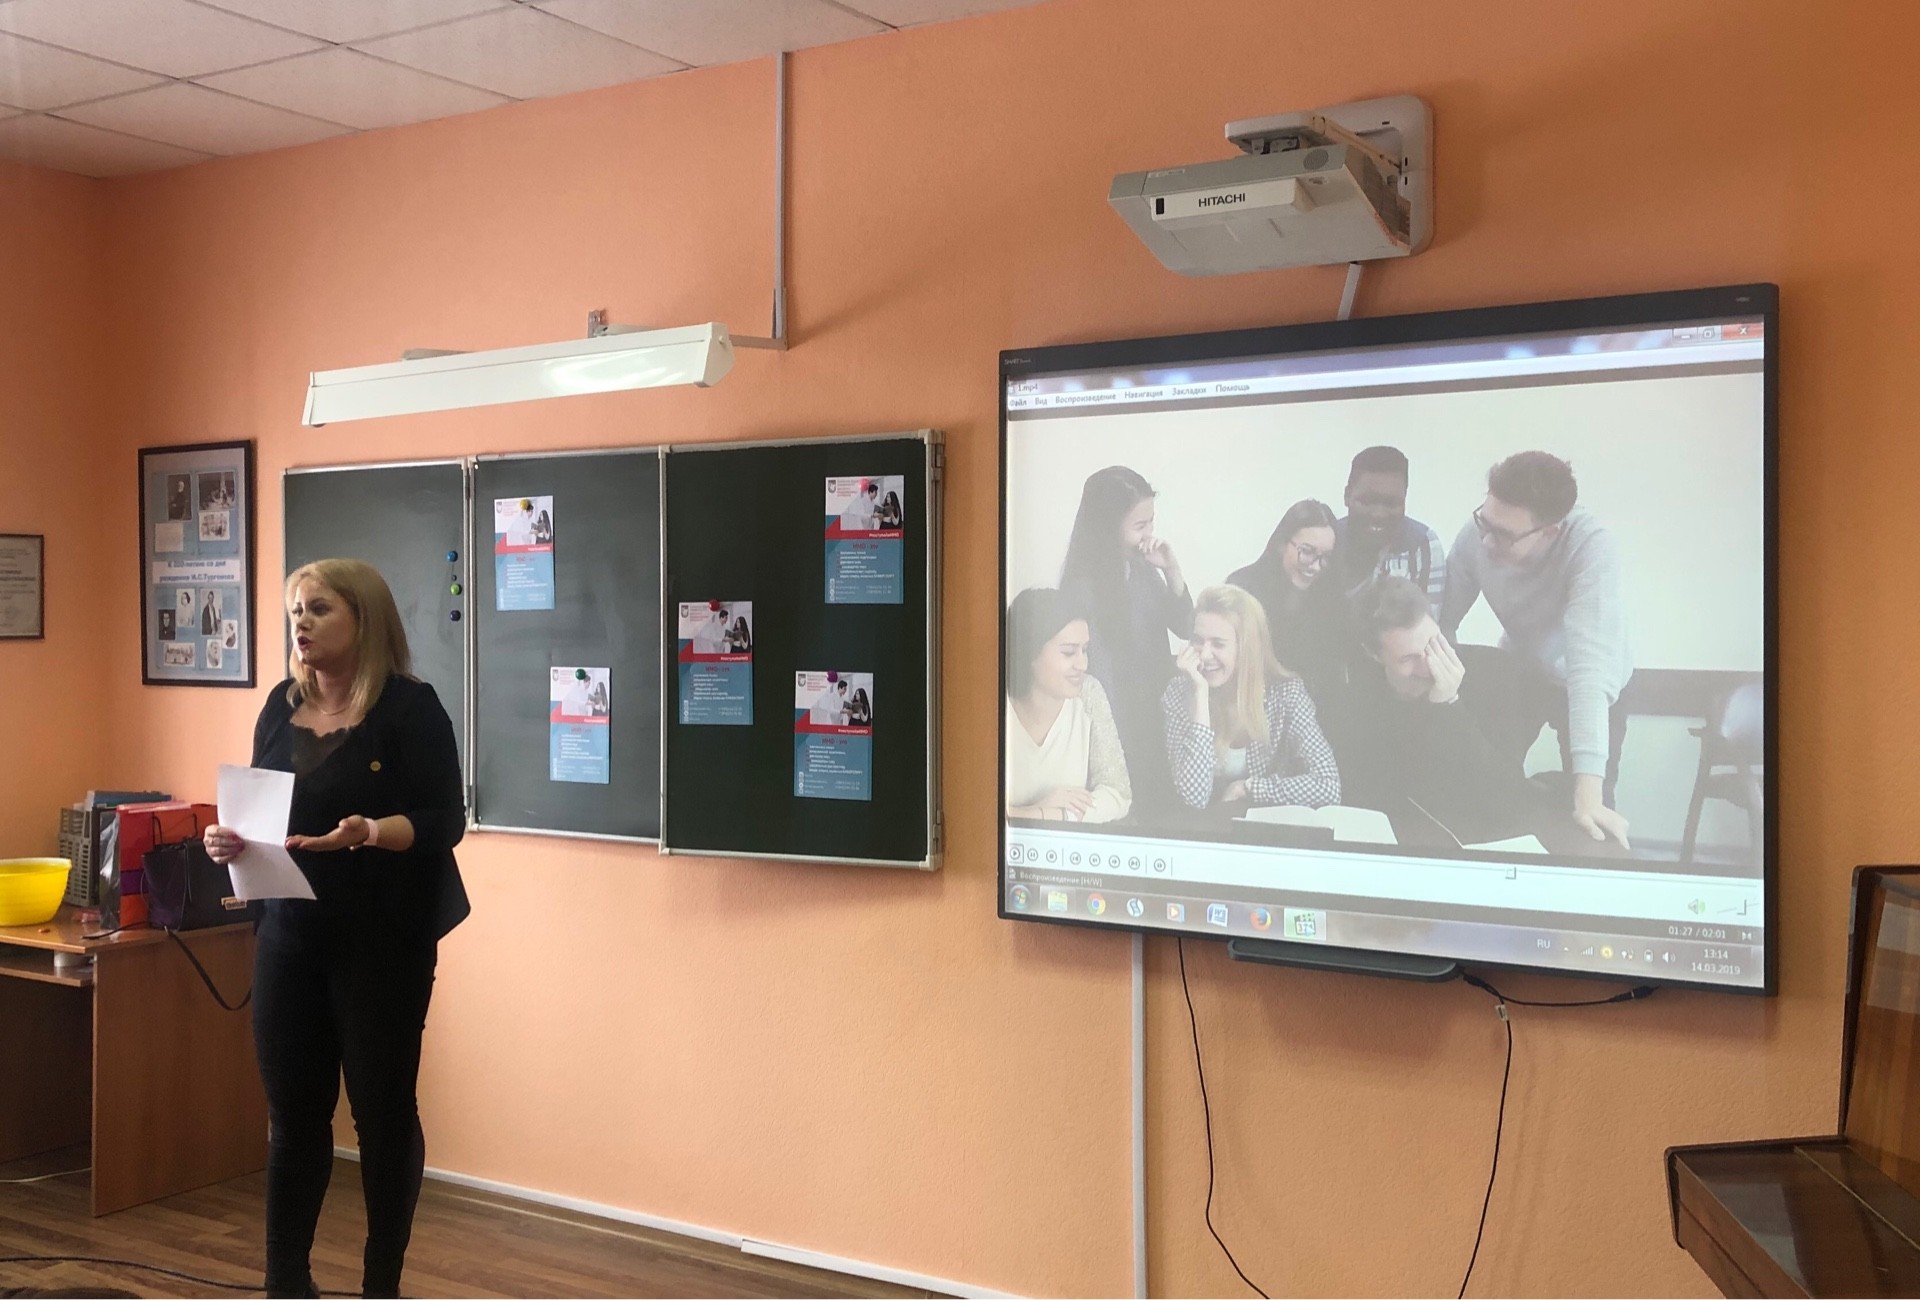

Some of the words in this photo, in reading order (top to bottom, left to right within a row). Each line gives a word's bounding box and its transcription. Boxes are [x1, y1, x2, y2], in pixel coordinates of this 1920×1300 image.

[1198, 193, 1246, 207] HITACHI
[1035, 397, 1048, 406] Вид
[1055, 393, 1117, 405] Воспроизведение
[1124, 390, 1163, 400] Навигация
[1172, 387, 1207, 397] Закладки
[1215, 383, 1250, 393] Помощь
[1020, 871, 1080, 884] Воспроизведение
[1668, 926, 1693, 937] 01:27
[1702, 928, 1726, 939] 02:01
[1537, 939, 1551, 949] RU
[1704, 949, 1729, 960] 13:14
[1691, 962, 1741, 975] 14.03.2019
